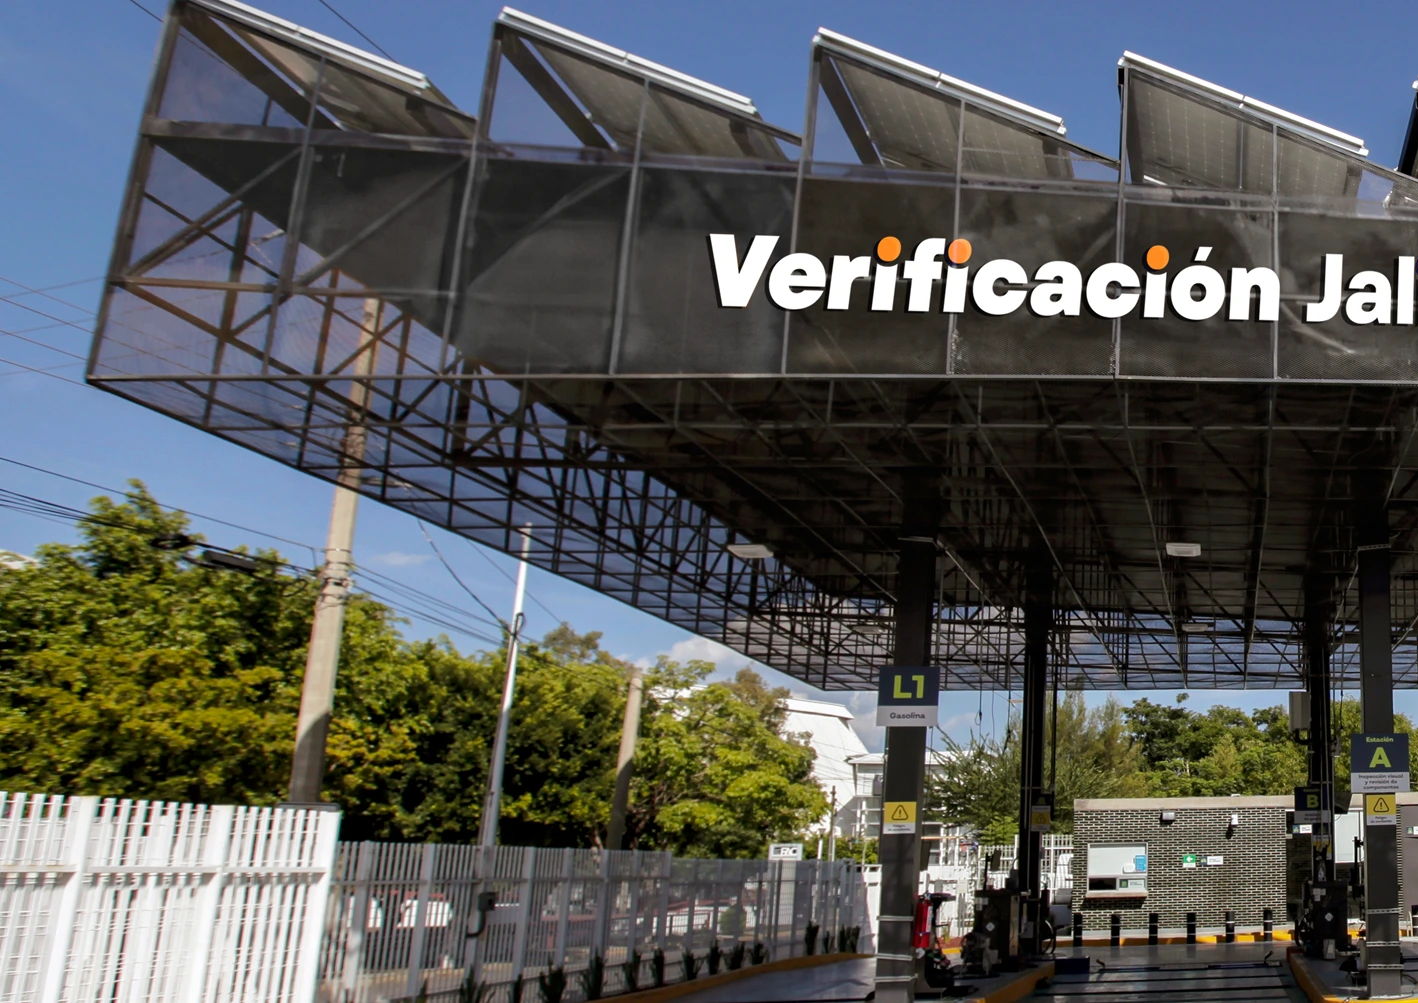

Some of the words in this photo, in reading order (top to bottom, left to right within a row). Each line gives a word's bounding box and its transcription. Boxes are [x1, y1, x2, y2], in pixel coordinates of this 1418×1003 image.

[709, 233, 1280, 321] Verificación
[893, 675, 925, 698] L1
[889, 711, 926, 719] Gasolina
[1369, 747, 1392, 768] A
[1307, 794, 1319, 808] B
